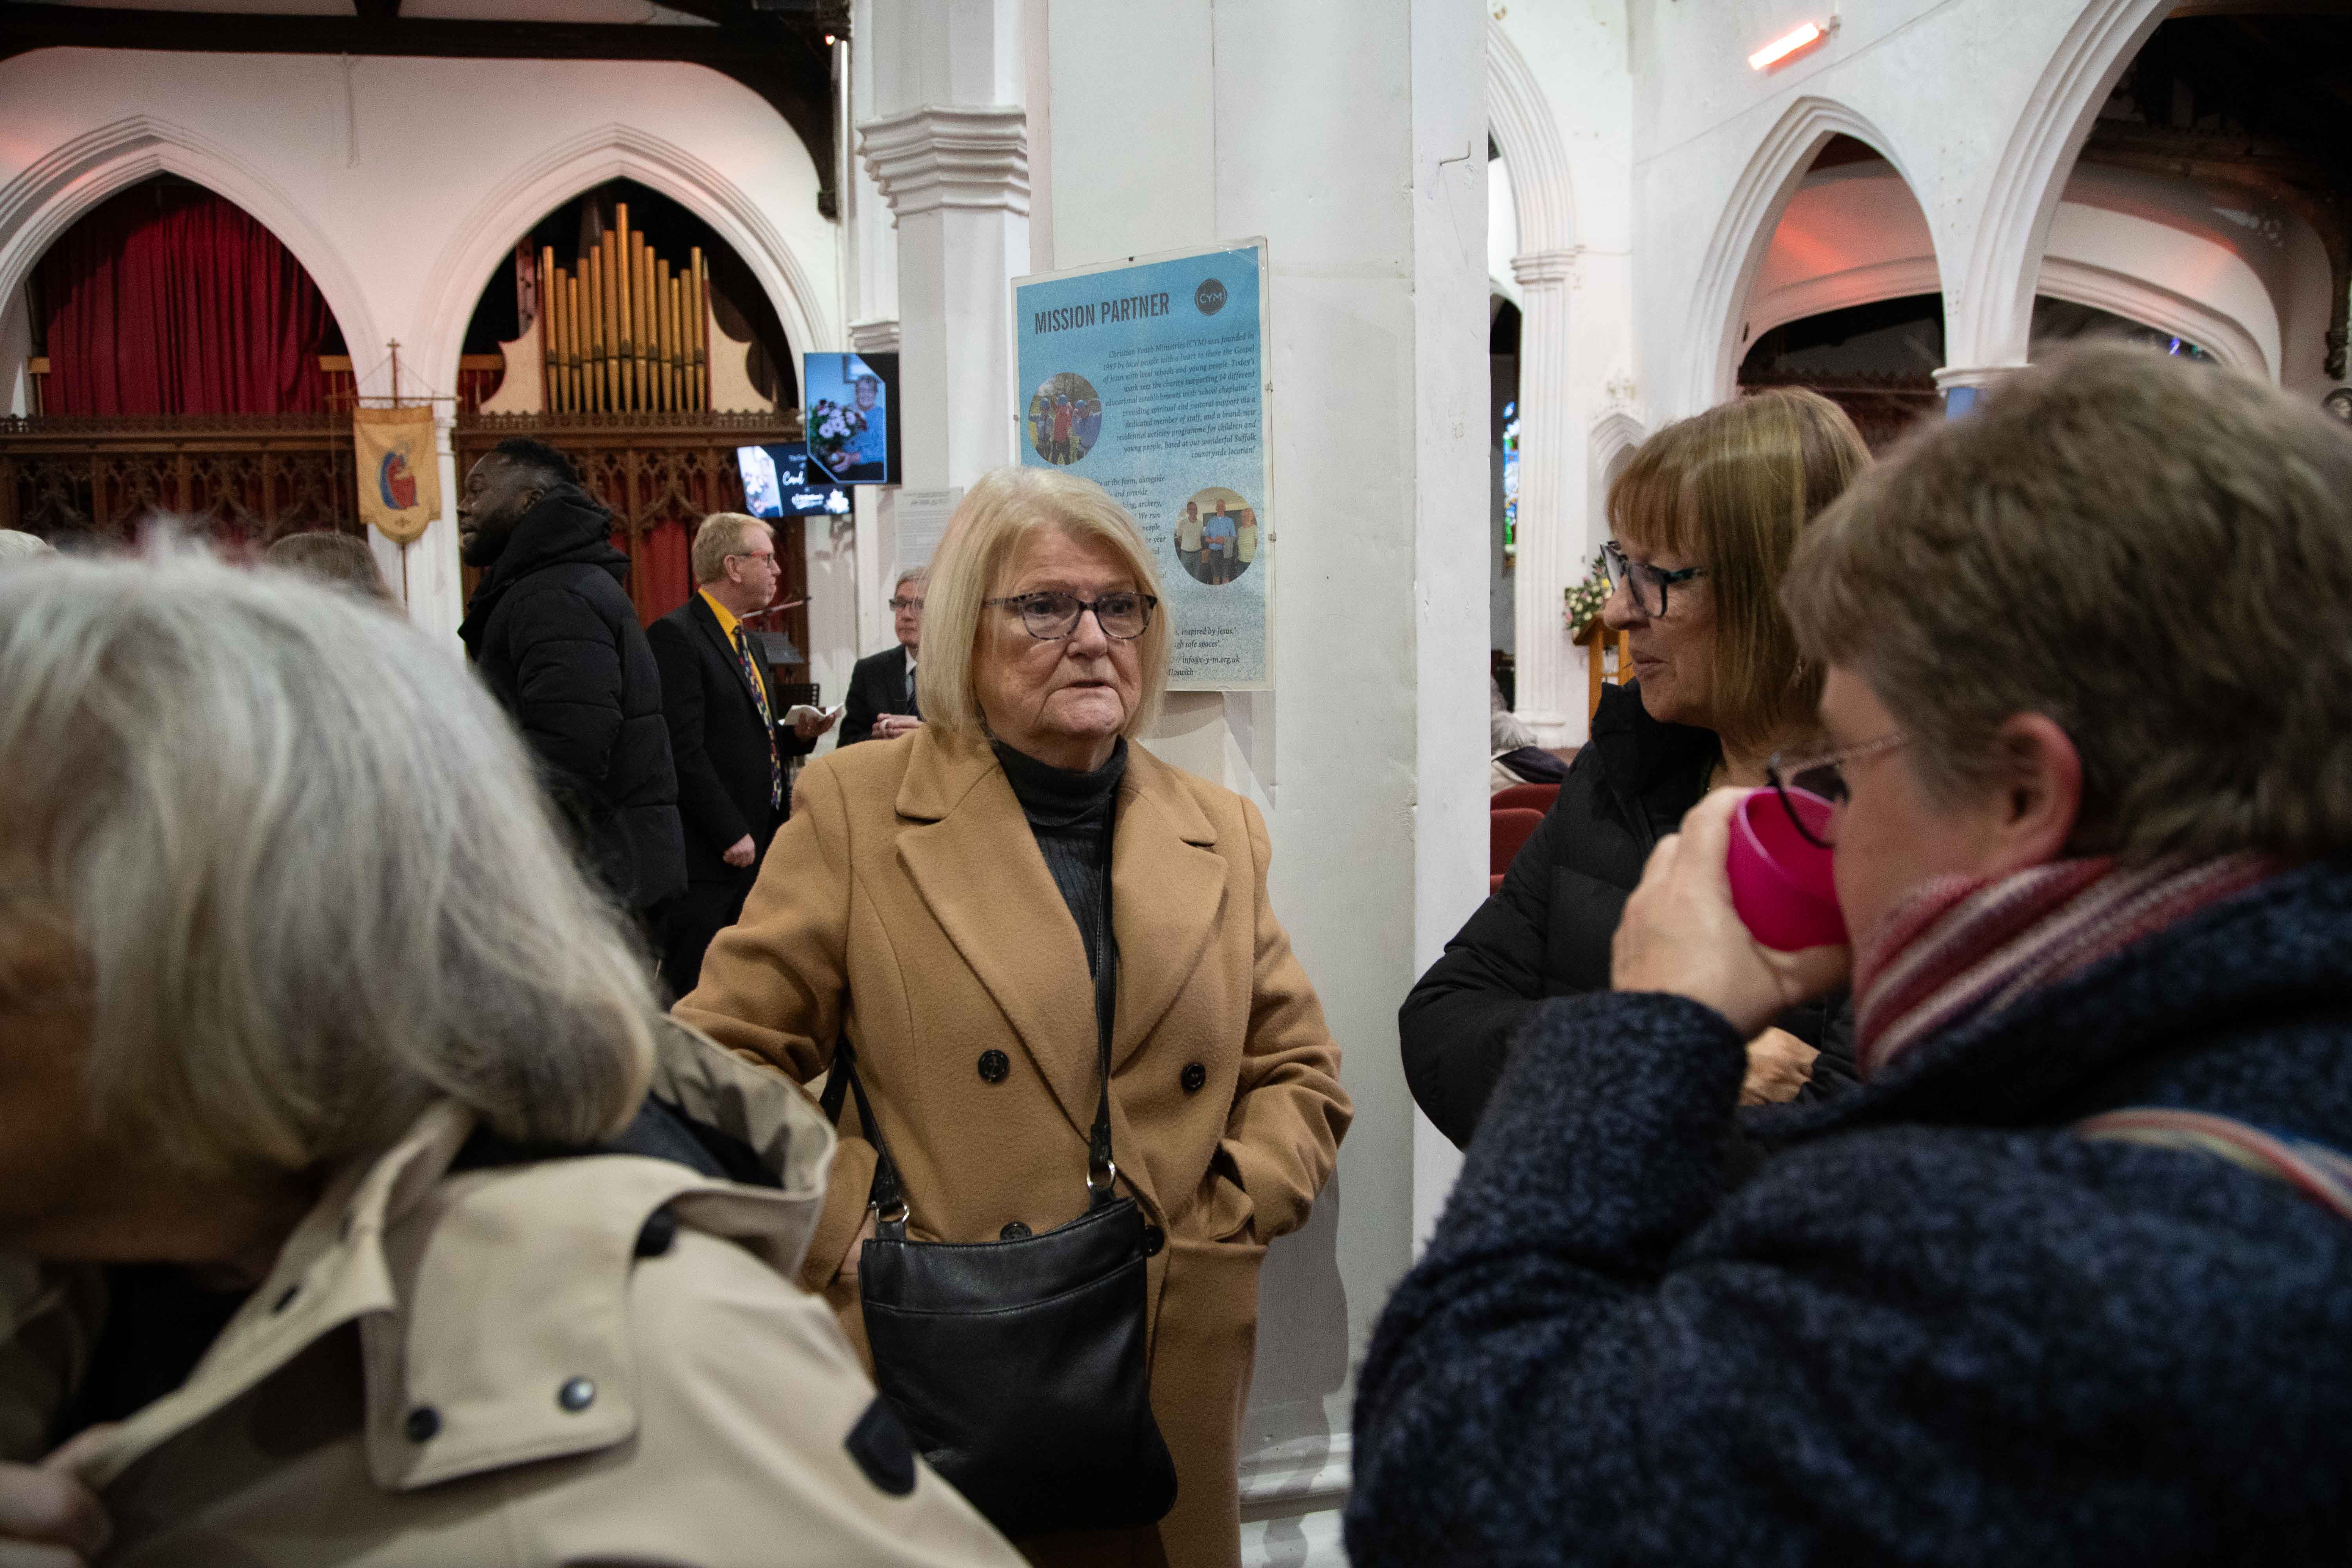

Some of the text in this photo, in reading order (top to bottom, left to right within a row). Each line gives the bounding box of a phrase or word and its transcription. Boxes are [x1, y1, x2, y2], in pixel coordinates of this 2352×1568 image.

[1200, 292, 1222, 304] CYM
[1035, 293, 1170, 334] MISSION PARTNER
[1109, 349, 1135, 358] Christian
[1137, 345, 1154, 354] Youth
[1156, 342, 1185, 352] Ministries
[1187, 338, 1206, 348] (CYM)
[1221, 333, 1246, 345] founded
[1126, 359, 1138, 368] local
[1141, 356, 1158, 367] people
[1160, 354, 1174, 363] with
[1234, 345, 1254, 354] Gospel
[1103, 376, 1109, 384] of
[1110, 375, 1124, 383] Jesus
[1125, 370, 1138, 380] with
[1140, 369, 1153, 378] local
[1154, 367, 1174, 376] schools
[1189, 365, 1207, 373] young
[1124, 384, 1138, 392] work
[1163, 379, 1183, 387] charity
[1186, 376, 1218, 385] supporting
[1228, 371, 1254, 381] different
[1105, 396, 1137, 407] educational
[1139, 392, 1181, 403] establishments
[1183, 389, 1196, 397] with
[1122, 408, 1150, 418] providing
[1151, 403, 1176, 414] spiritual
[1178, 402, 1189, 410] and
[1190, 399, 1214, 410] pastoral
[1216, 398, 1239, 407] support
[1125, 419, 1152, 428] dedicated
[1154, 417, 1178, 425] member
[1179, 415, 1185, 423] of
[1204, 411, 1215, 420] and
[1222, 409, 1255, 417] brand-new
[1117, 420, 1256, 441] residential activity programme for children and
[1123, 444, 1142, 454] young
[1165, 440, 1180, 449] based
[1202, 436, 1233, 445] wonderful
[1234, 432, 1257, 443] Suffolk
[1191, 448, 1227, 458] countryside
[1122, 477, 1137, 486] farm,
[1139, 474, 1165, 484] alongside
[1126, 488, 1148, 497] provide
[1181, 627, 1207, 636] Inspired
[1208, 627, 1216, 636] by
[1185, 640, 1196, 649] safe
